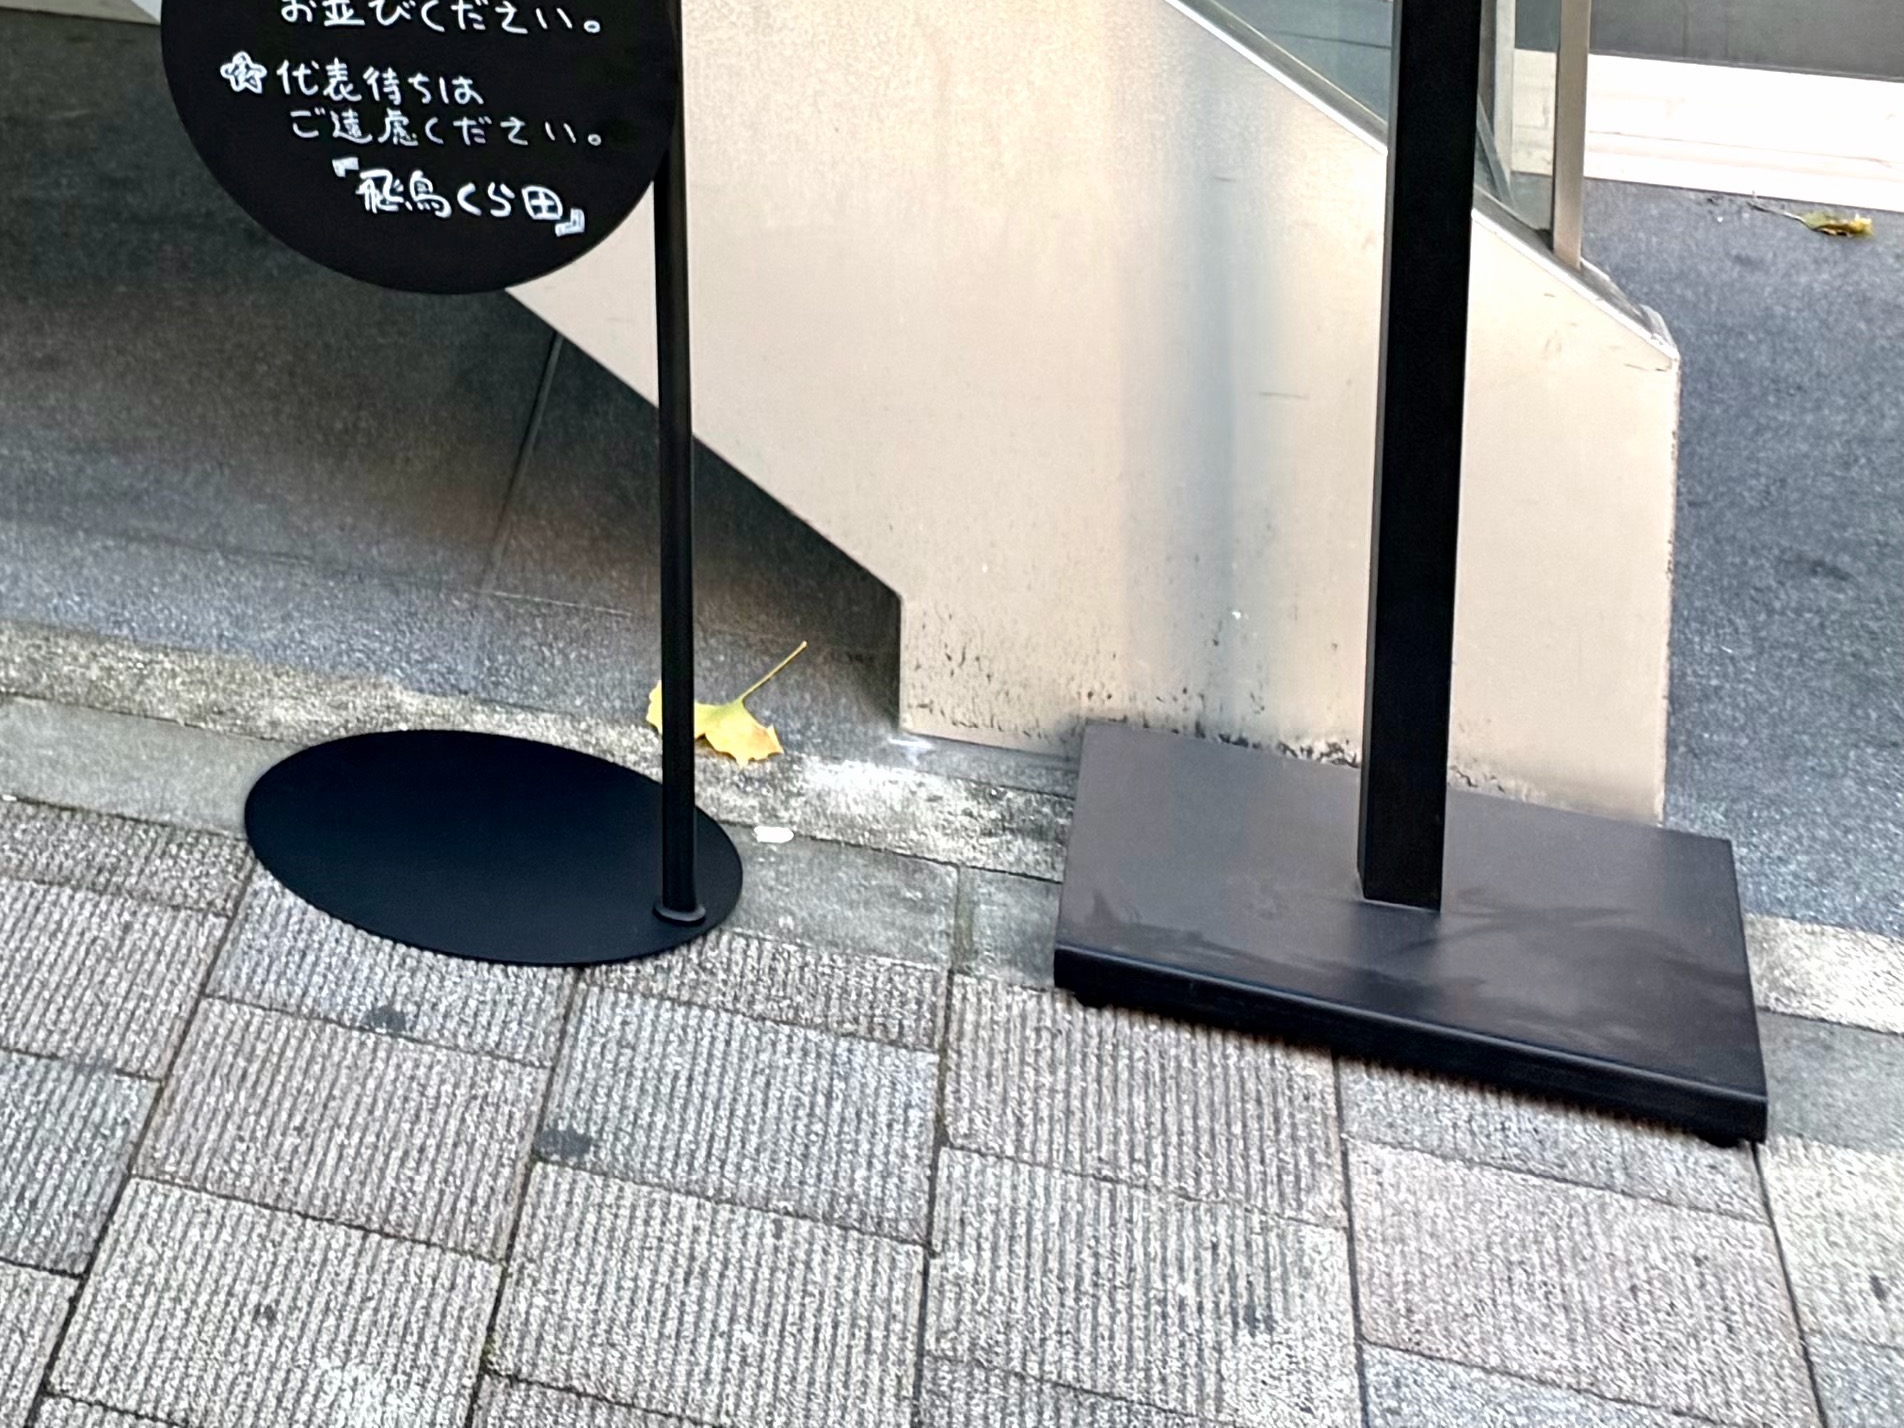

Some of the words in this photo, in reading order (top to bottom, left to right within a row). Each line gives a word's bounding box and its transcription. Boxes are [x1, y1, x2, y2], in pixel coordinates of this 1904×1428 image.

[276, 56, 485, 106] 代表待ちは
[289, 108, 603, 148] ご遠慮ください。
